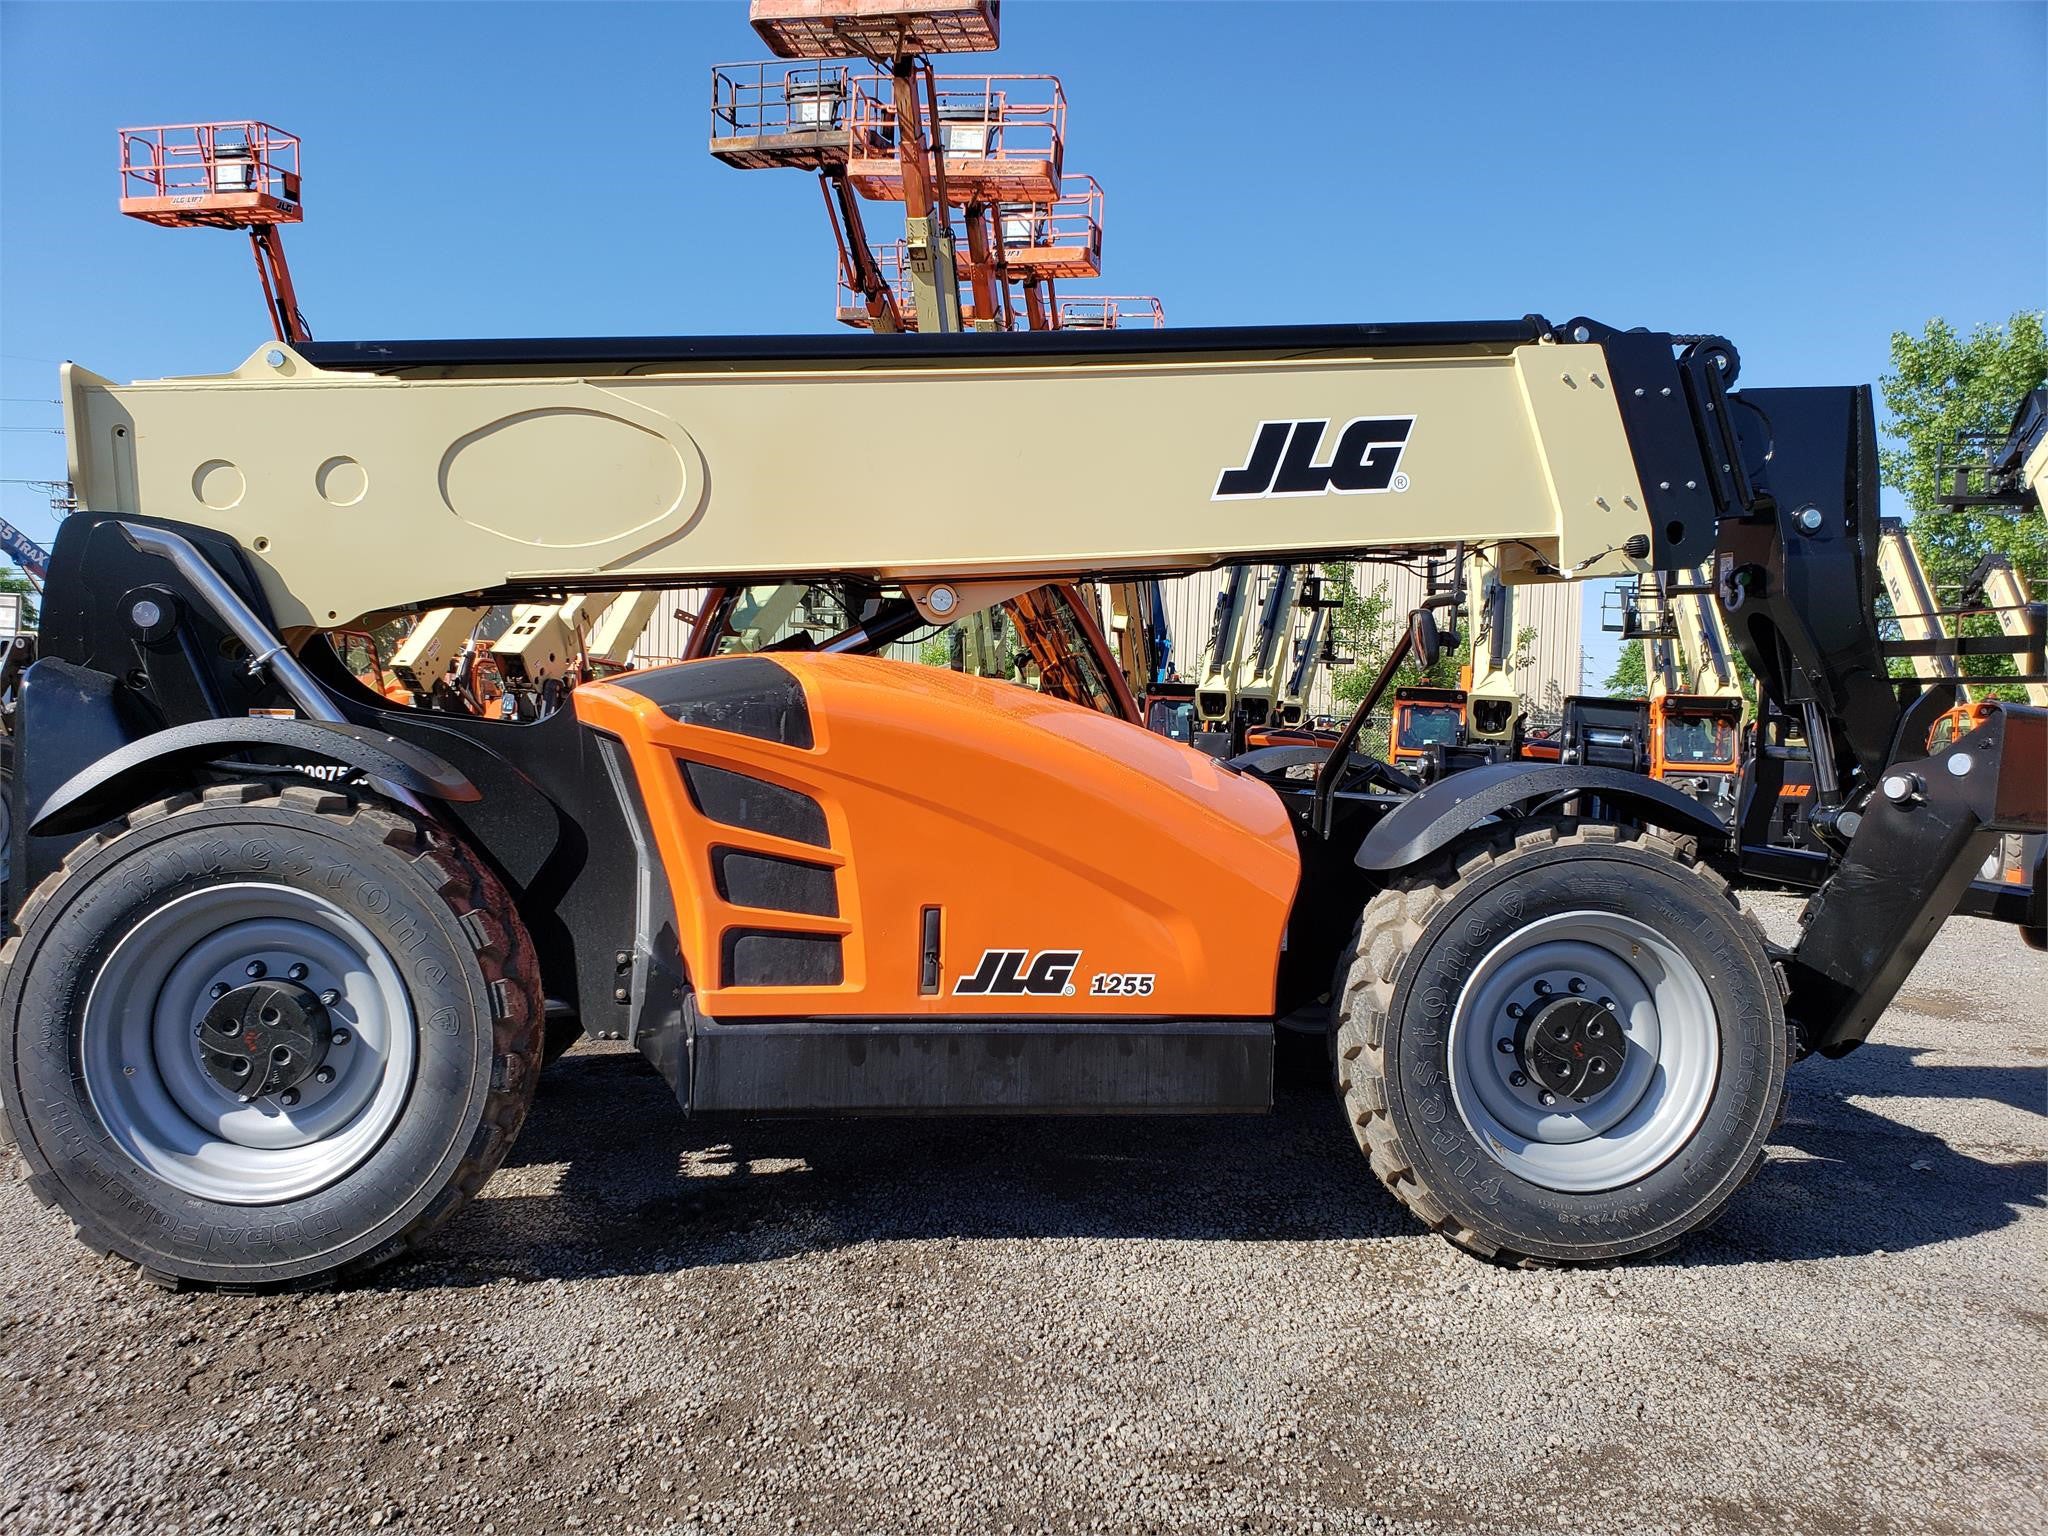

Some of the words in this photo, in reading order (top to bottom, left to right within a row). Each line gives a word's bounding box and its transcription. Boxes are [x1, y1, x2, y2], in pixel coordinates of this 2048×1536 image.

[276, 201, 293, 213] JLG
[1211, 414, 1417, 500] JLG
[13, 534, 50, 566] TRAX
[1889, 576, 1902, 603] JLG
[2000, 609, 2012, 629] LG
[953, 950, 1082, 996] JLG
[1090, 974, 1155, 996] 1255
